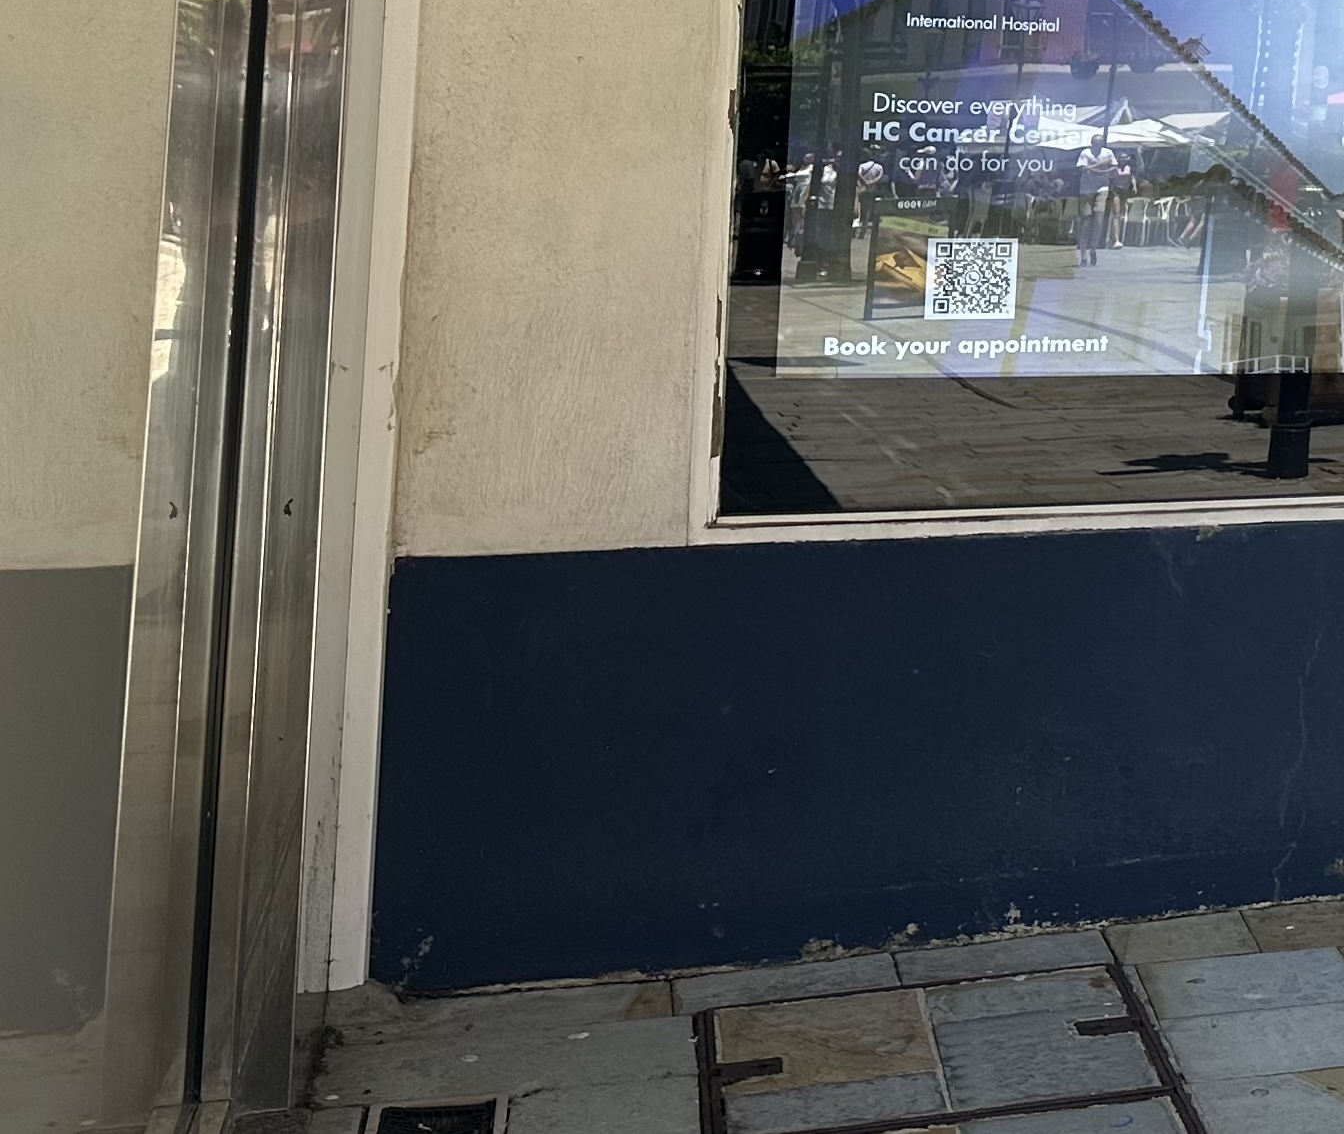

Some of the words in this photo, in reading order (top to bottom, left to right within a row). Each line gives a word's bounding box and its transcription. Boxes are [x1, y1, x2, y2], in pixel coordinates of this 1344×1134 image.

[907, 12, 996, 30] International
[1002, 16, 1060, 35] Hospital
[873, 92, 963, 114] Discover
[970, 95, 1076, 122] everything
[863, 121, 900, 141] HC
[909, 122, 1000, 143] Cancer
[900, 156, 937, 171] can
[946, 148, 973, 171] do
[981, 150, 1009, 171] for
[1016, 158, 1054, 177] you
[824, 335, 886, 356] Book
[895, 340, 951, 360] your
[958, 334, 1108, 358] appointment
